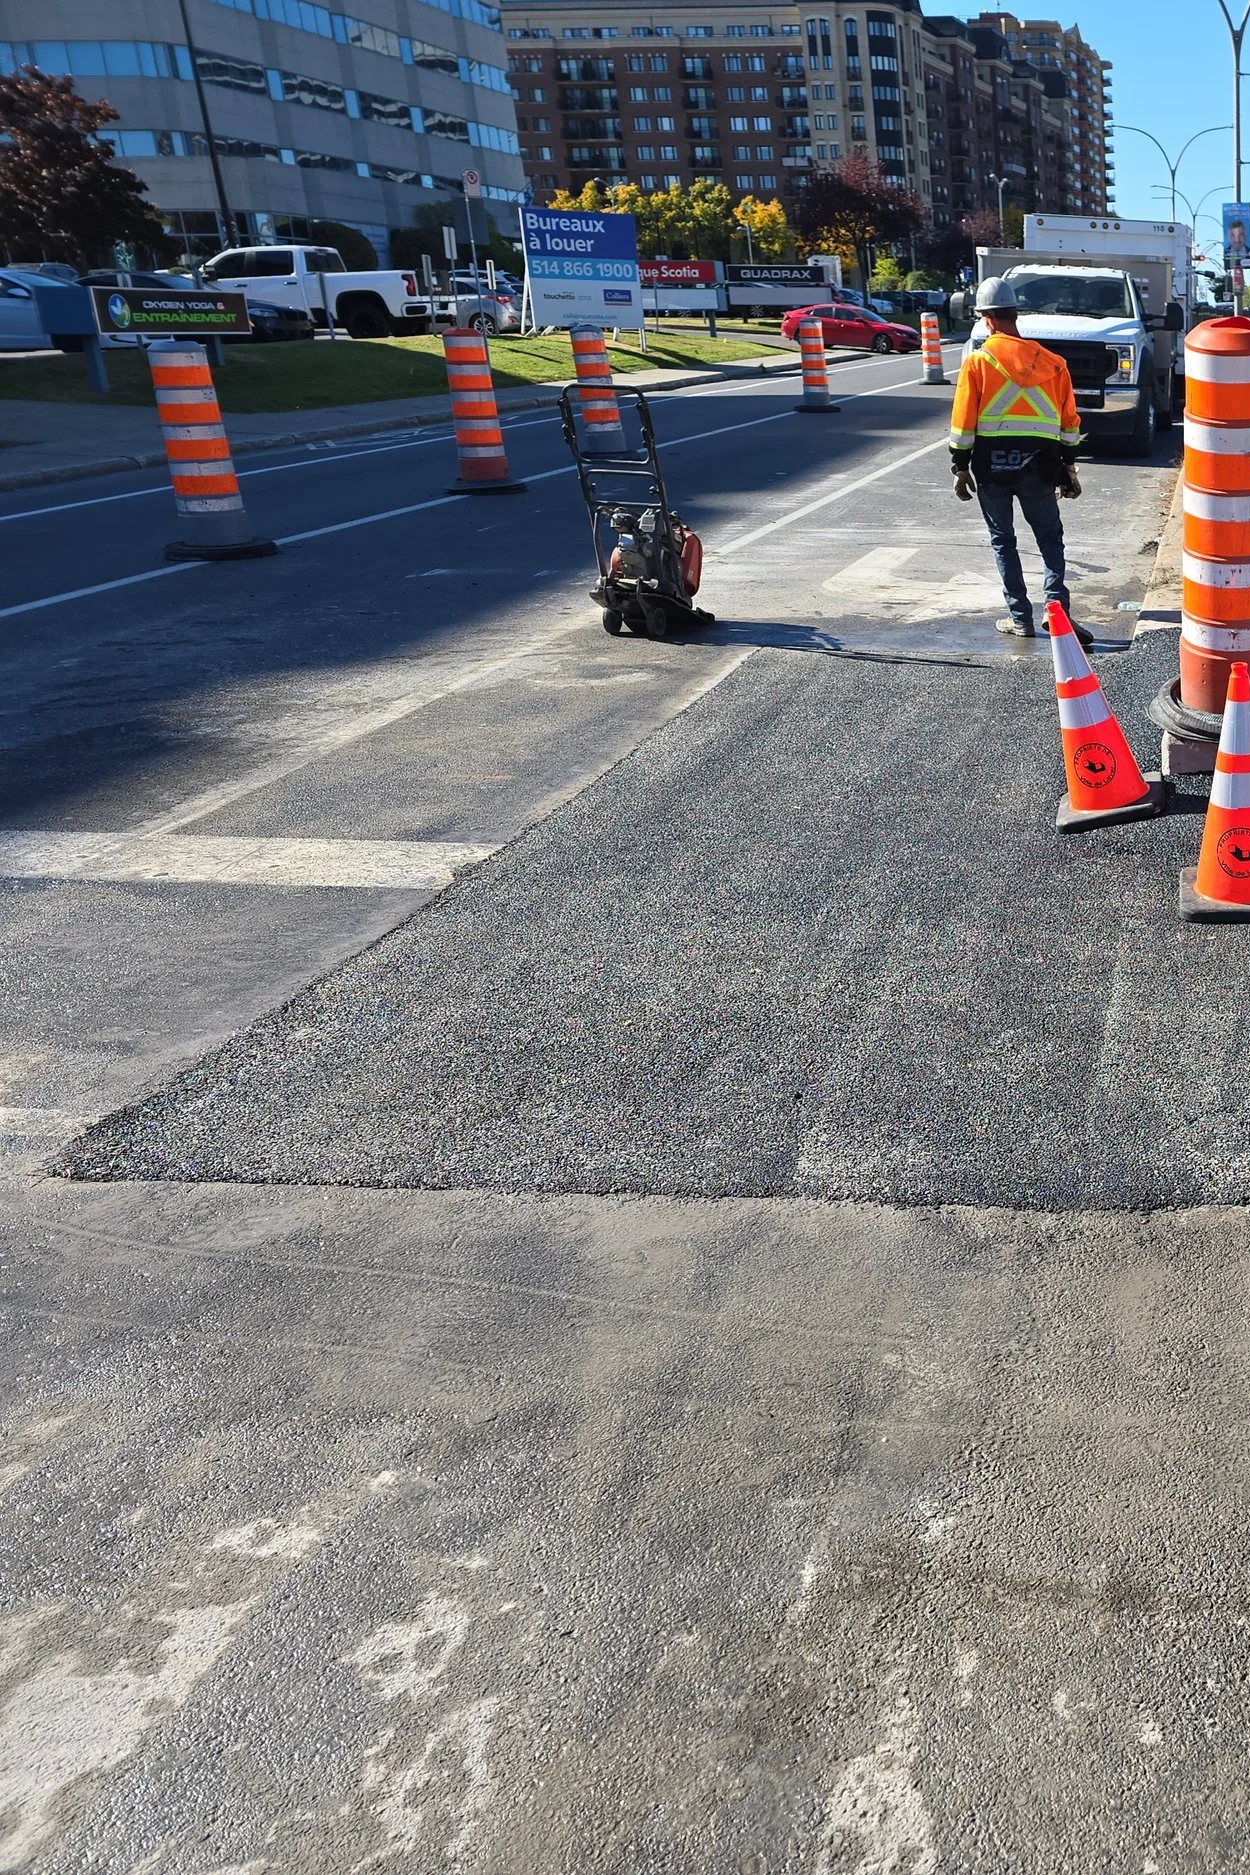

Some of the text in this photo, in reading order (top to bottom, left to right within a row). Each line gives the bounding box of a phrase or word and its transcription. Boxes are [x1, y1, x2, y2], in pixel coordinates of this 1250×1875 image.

[526, 213, 606, 233] Bureaux
[529, 233, 594, 252] à louer
[532, 260, 633, 278] 514 866 1900
[661, 266, 699, 278] Scotia
[740, 270, 812, 278] QUADRAX
[142, 300, 184, 310] OXYGEN
[186, 302, 214, 310] YOGA
[133, 310, 237, 322] ENTRAÎNEMENT
